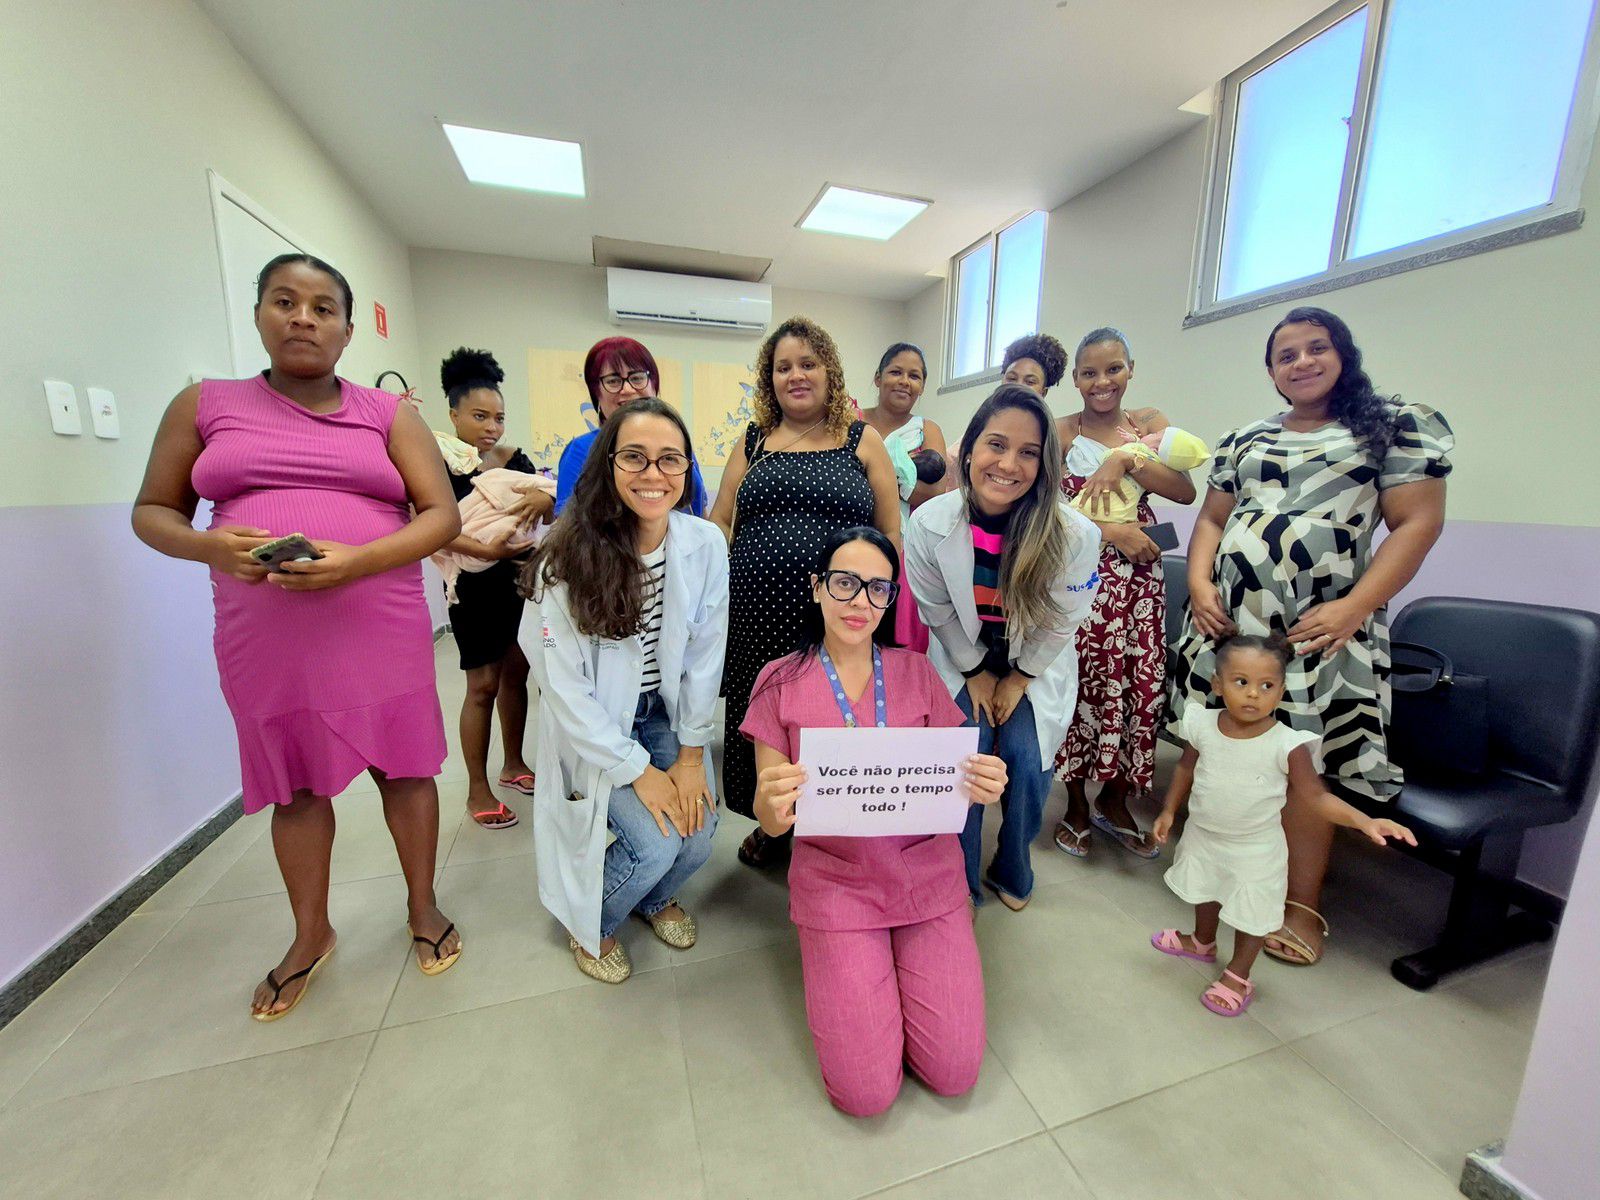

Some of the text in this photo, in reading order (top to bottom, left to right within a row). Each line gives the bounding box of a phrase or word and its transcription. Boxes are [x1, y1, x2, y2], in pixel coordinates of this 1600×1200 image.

[818, 763, 956, 778] Você não precisa
[816, 787, 842, 796] ser
[846, 784, 886, 795] forte
[905, 783, 954, 795] tempo
[861, 802, 896, 812] todo
